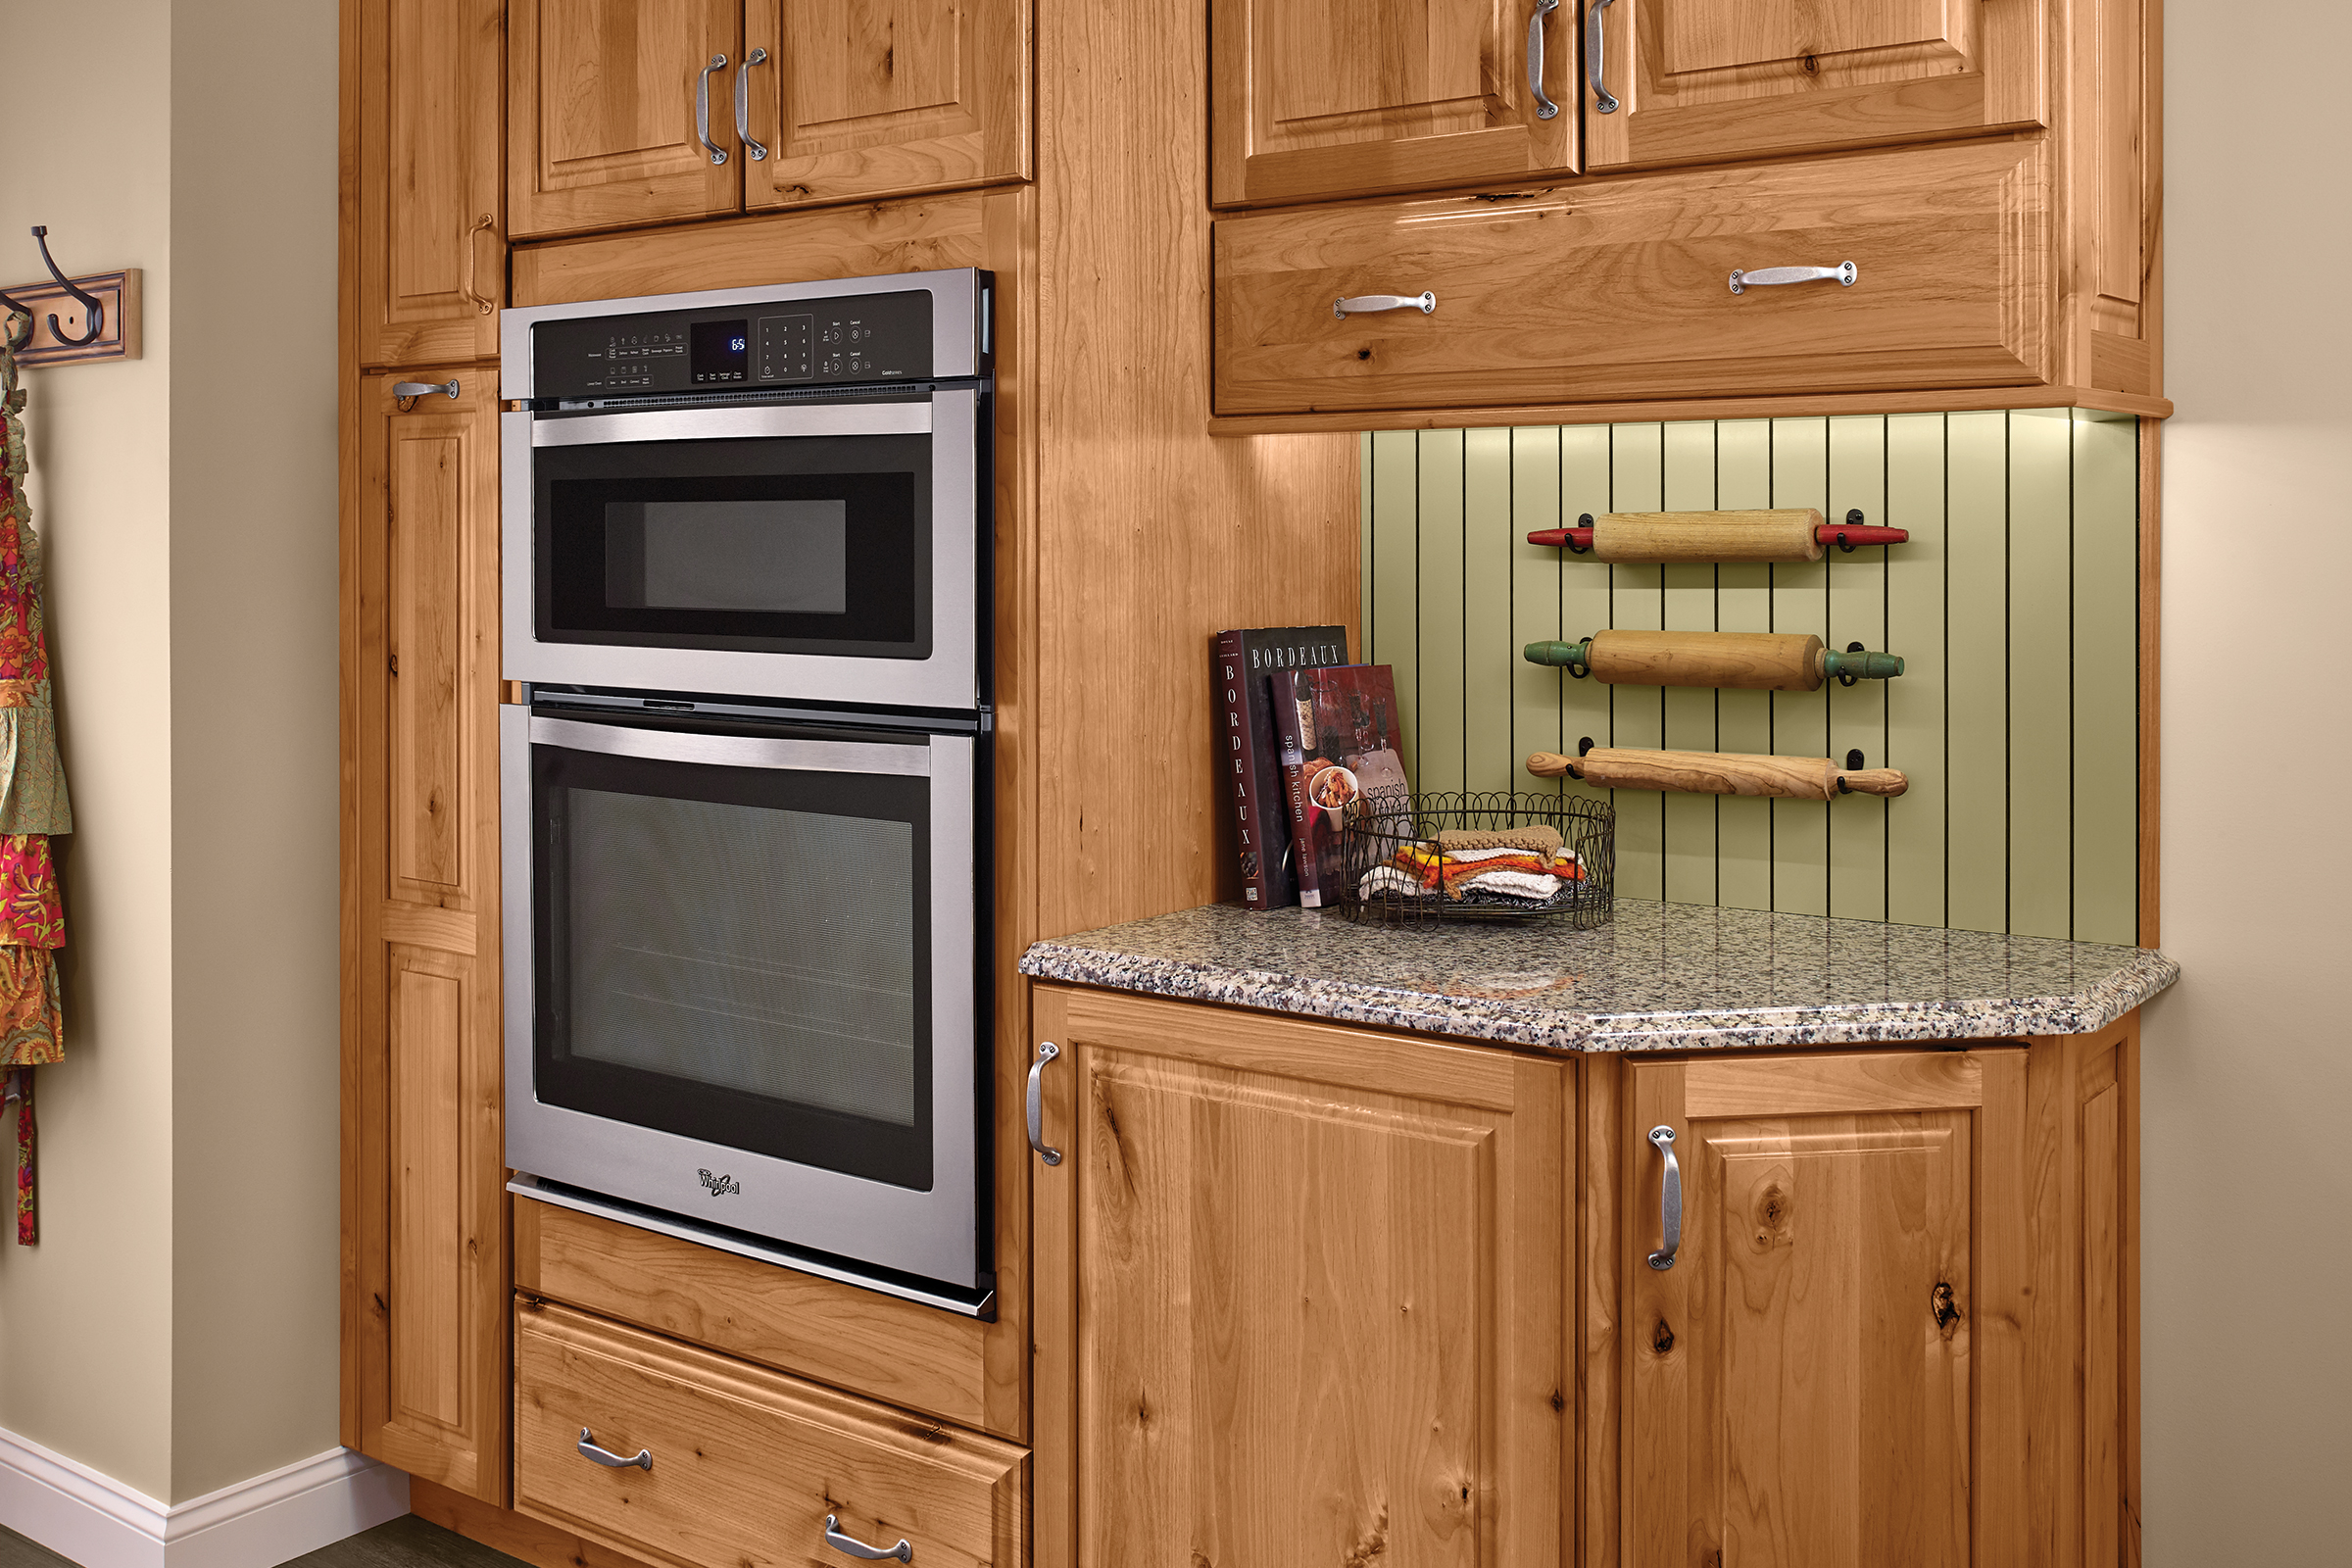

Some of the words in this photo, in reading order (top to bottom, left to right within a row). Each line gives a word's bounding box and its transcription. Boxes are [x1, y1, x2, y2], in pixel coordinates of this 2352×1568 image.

[1252, 645, 1339, 669] BORDEAUX
[1225, 664, 1250, 845] BORDEAUX
[1285, 735, 1299, 778] spanish
[1292, 781, 1303, 822] kitchen
[1367, 778, 1406, 801] spanish
[1300, 853, 1309, 877] lawson
[698, 1170, 740, 1197] Whirlpool
